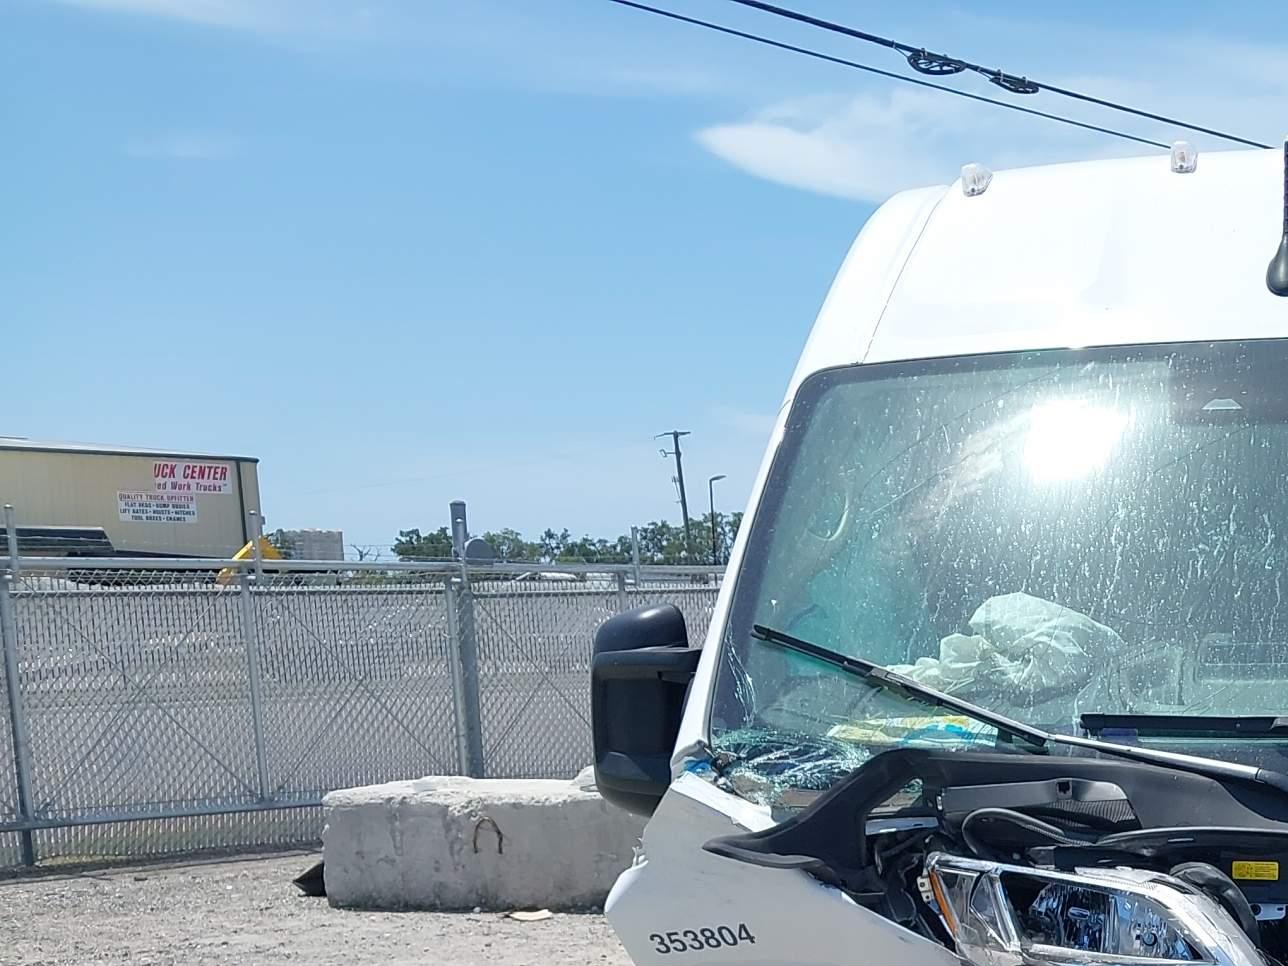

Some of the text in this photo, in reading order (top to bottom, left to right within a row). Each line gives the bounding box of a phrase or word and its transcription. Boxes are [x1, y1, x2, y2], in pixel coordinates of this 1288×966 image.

[154, 463, 228, 481] UCK CENTER
[170, 481, 191, 491] Work
[118, 493, 143, 501] QUALITY
[649, 923, 756, 954] 353804
